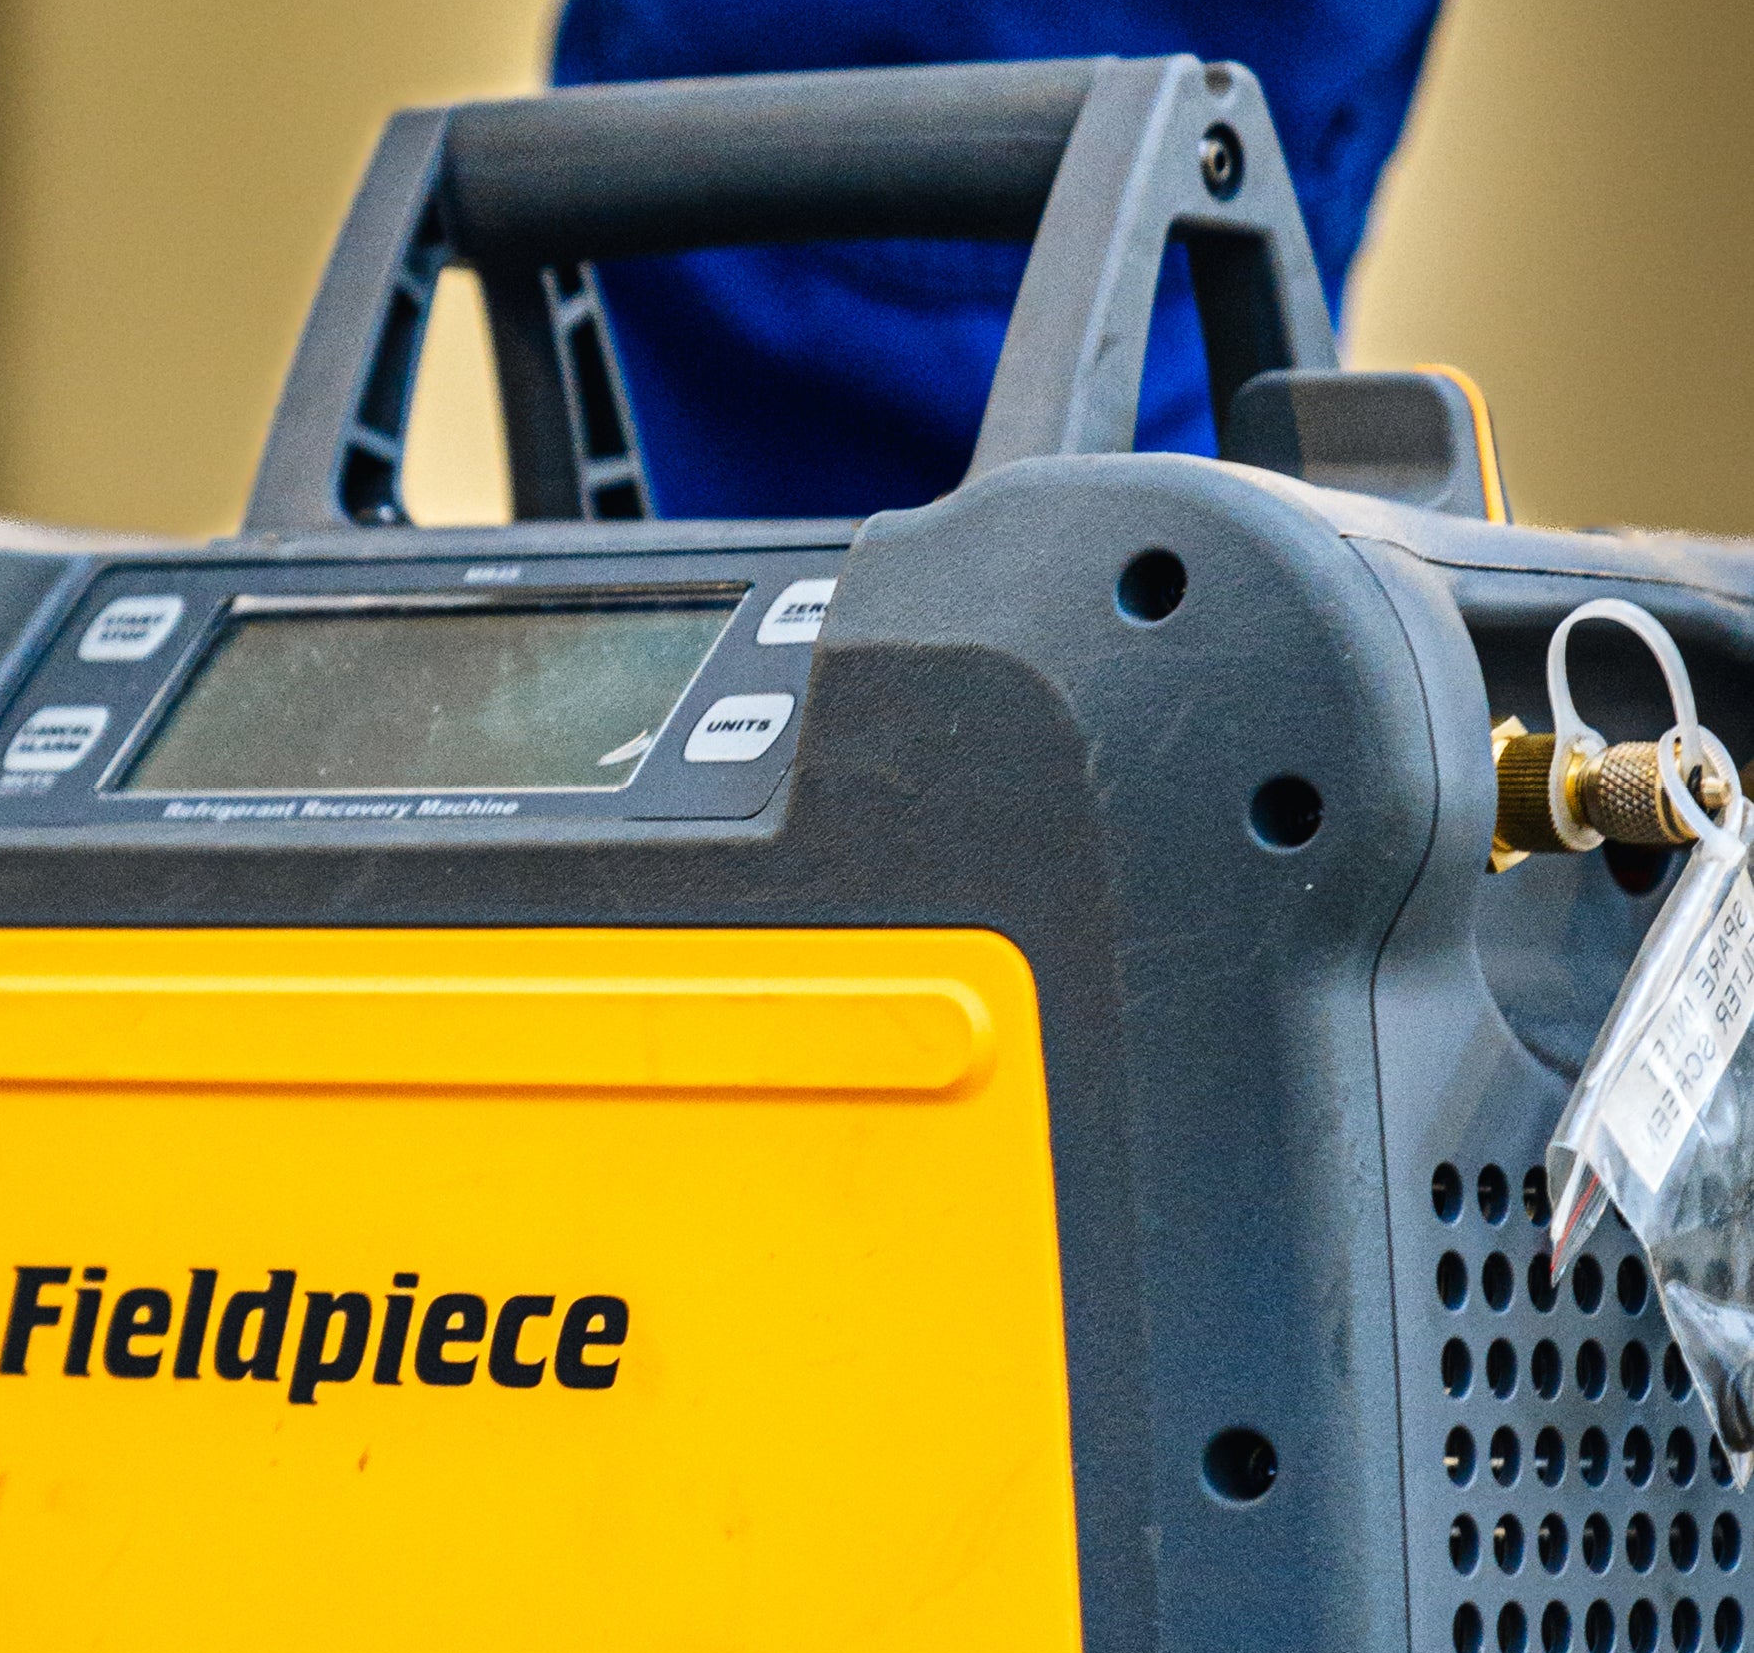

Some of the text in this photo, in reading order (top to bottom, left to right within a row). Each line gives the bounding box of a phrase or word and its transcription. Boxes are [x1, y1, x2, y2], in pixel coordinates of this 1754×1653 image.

[782, 602, 829, 615] ZER
[707, 719, 771, 733] UNITS
[162, 798, 520, 821] Refrigerant Recovery Machine
